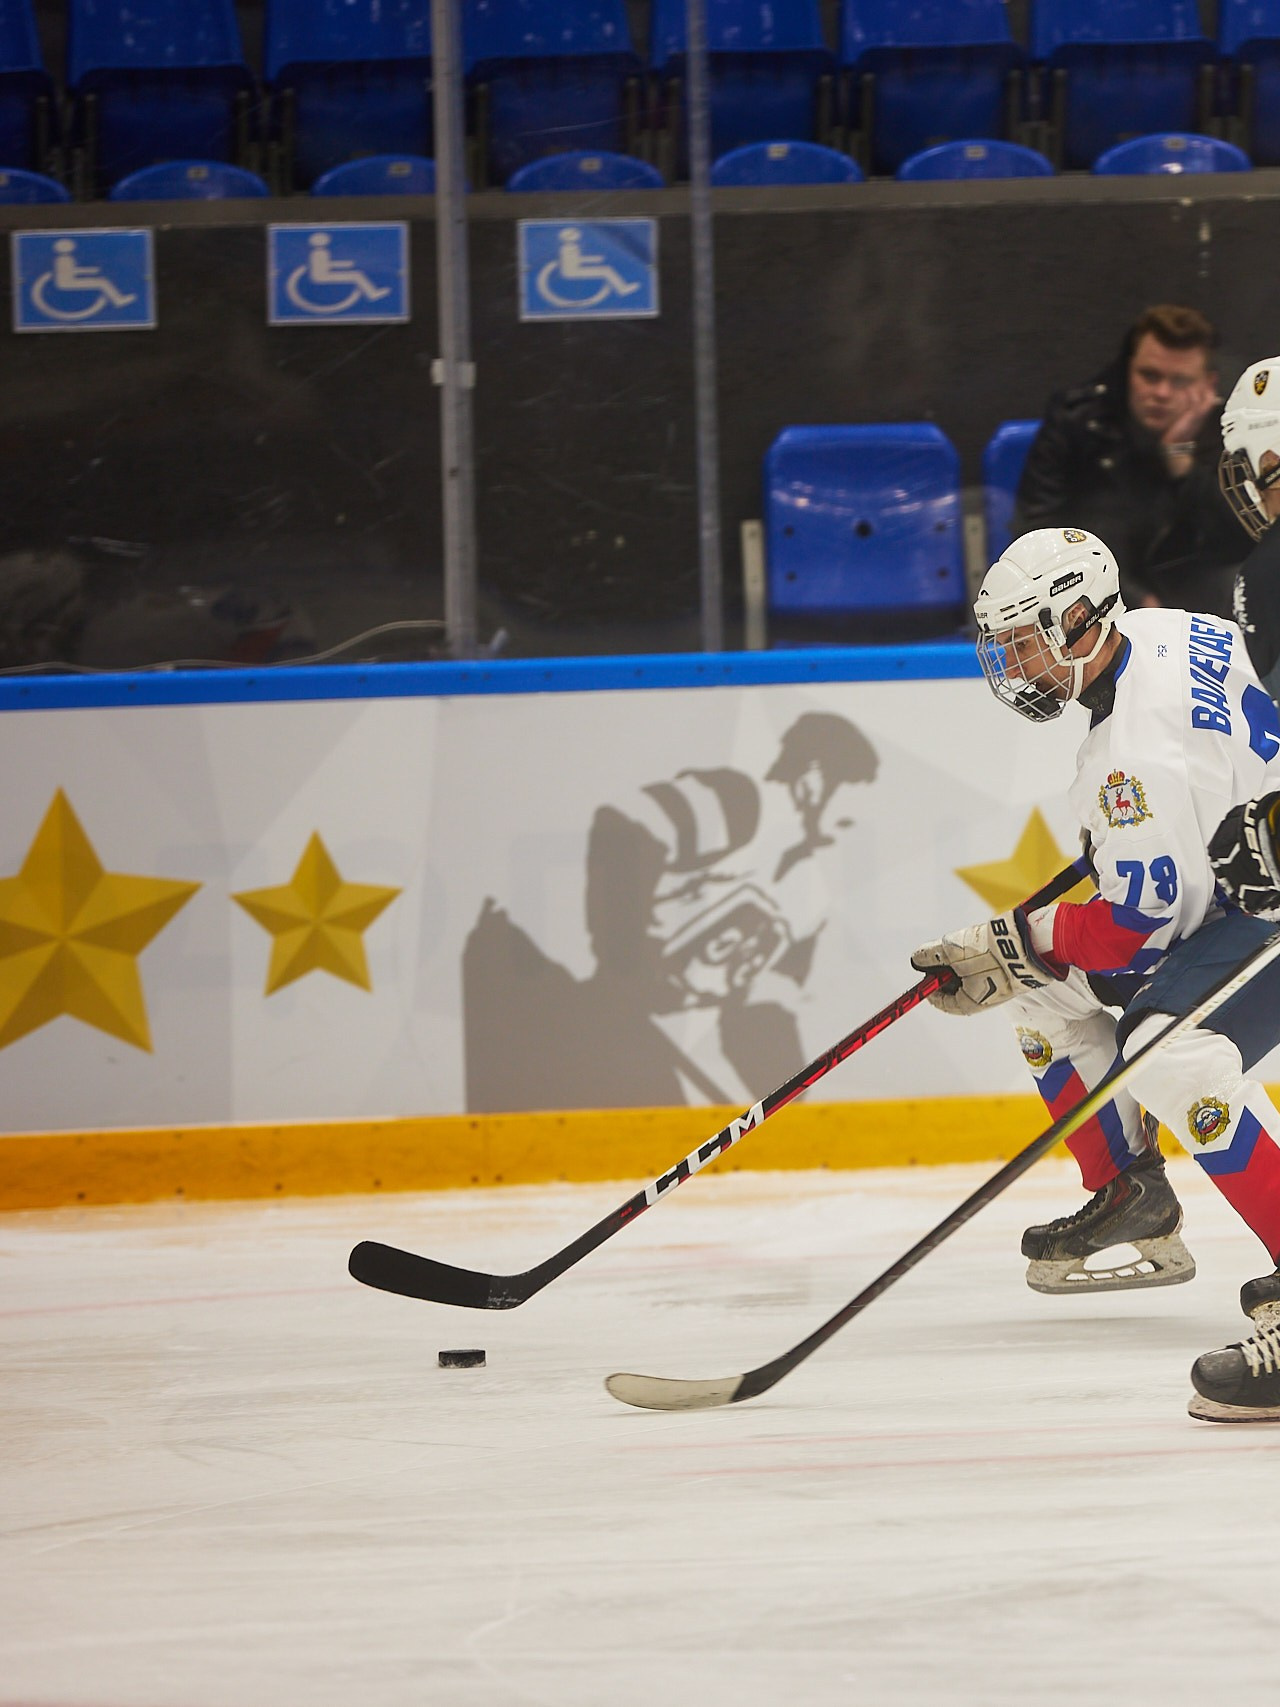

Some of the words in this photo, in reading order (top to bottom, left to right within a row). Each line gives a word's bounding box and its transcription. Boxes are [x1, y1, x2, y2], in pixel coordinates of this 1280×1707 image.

[1051, 574, 1082, 596] BAUER
[1115, 855, 1178, 908] 78
[645, 1099, 766, 1206] CCM
